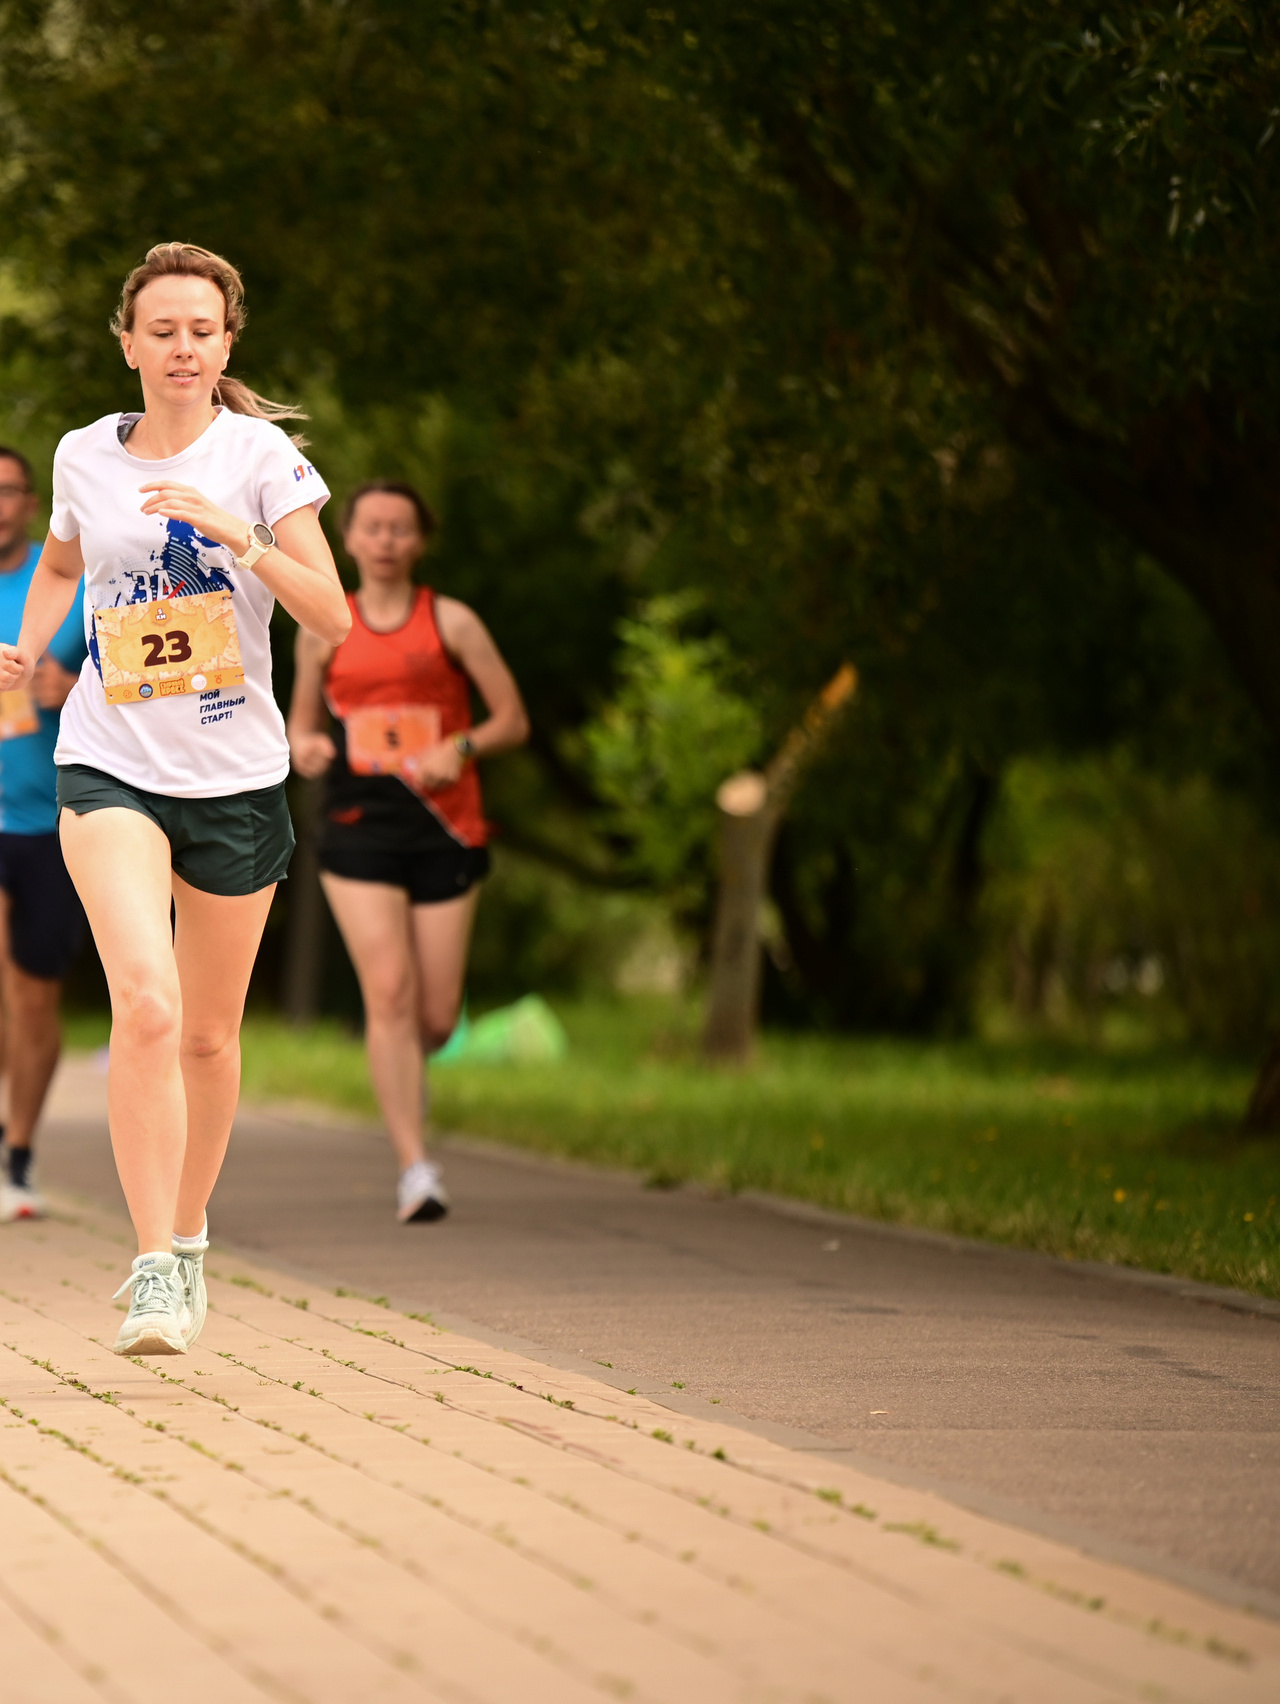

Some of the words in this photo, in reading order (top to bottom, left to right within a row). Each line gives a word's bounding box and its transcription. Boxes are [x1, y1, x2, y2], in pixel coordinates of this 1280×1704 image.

[141, 630, 192, 667] 23
[200, 689, 220, 701] МОЙ
[200, 696, 245, 713] ГЛАВНЫЙ
[201, 710, 232, 725] СТАРТ!
